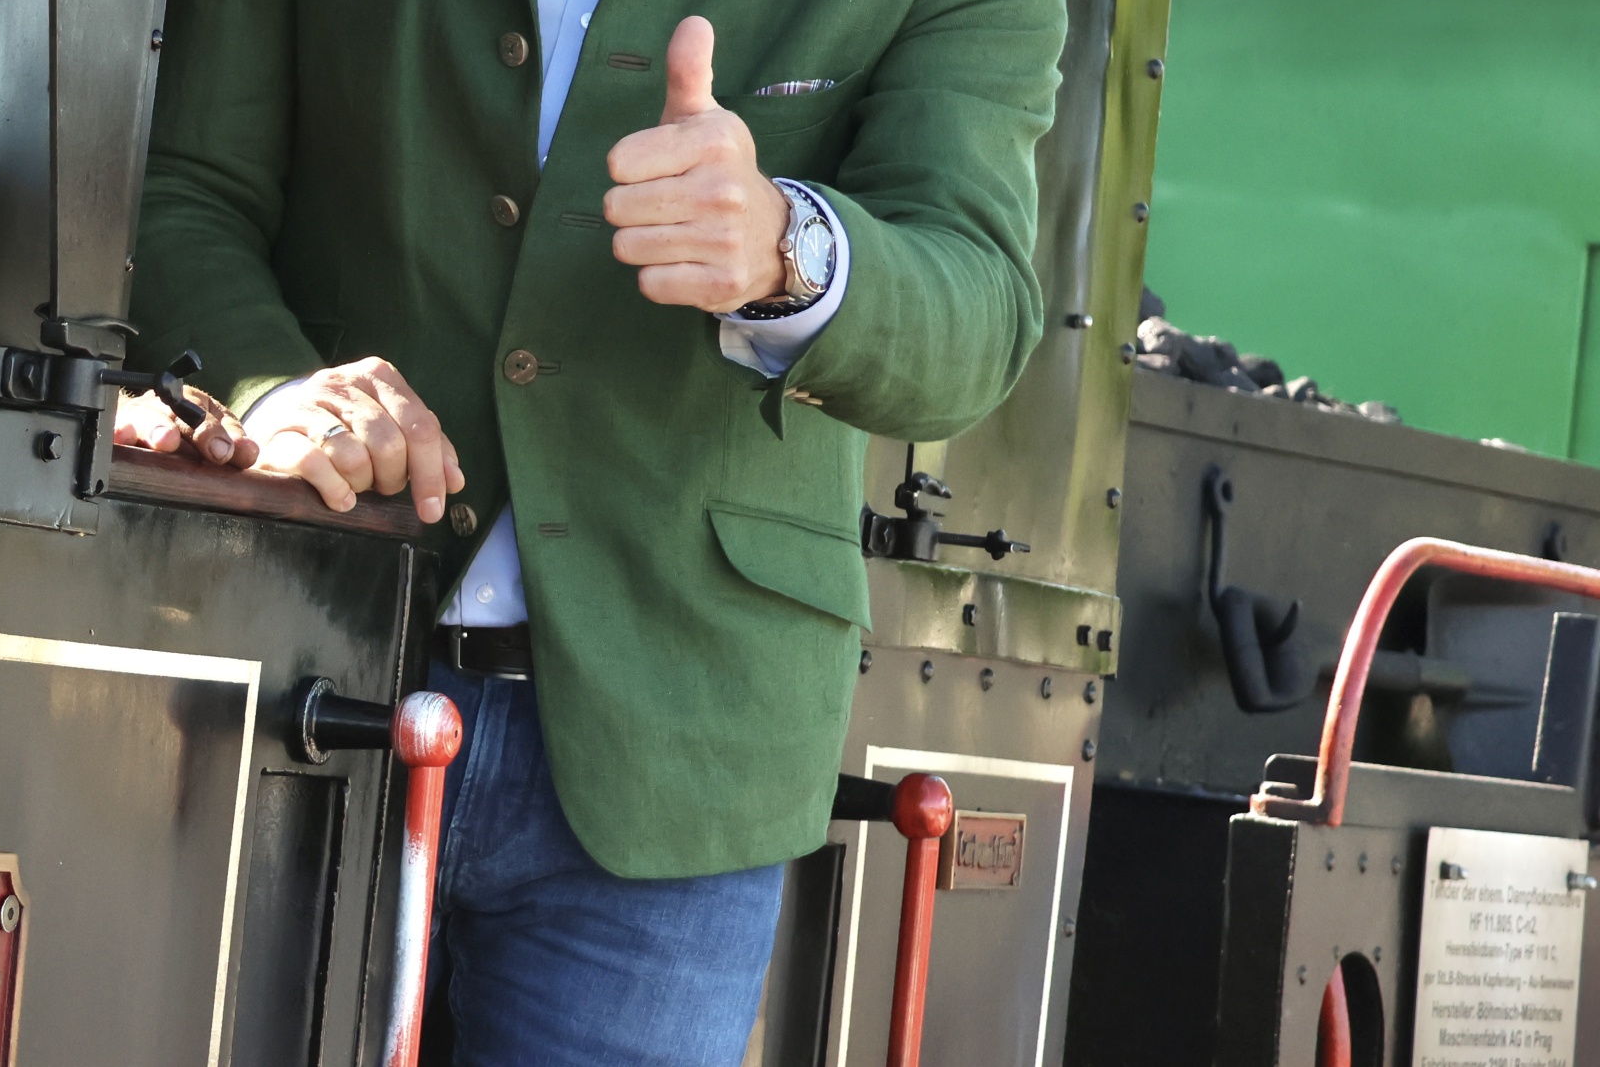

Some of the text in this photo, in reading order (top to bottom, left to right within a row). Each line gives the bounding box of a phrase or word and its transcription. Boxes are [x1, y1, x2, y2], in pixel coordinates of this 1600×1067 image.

[1462, 885, 1476, 902] der
[1469, 912, 1483, 931] HF
[1439, 1027, 1507, 1048] Maschinenfabrik
[1509, 1029, 1523, 1048] AG
[1533, 1030, 1553, 1053] Prag
